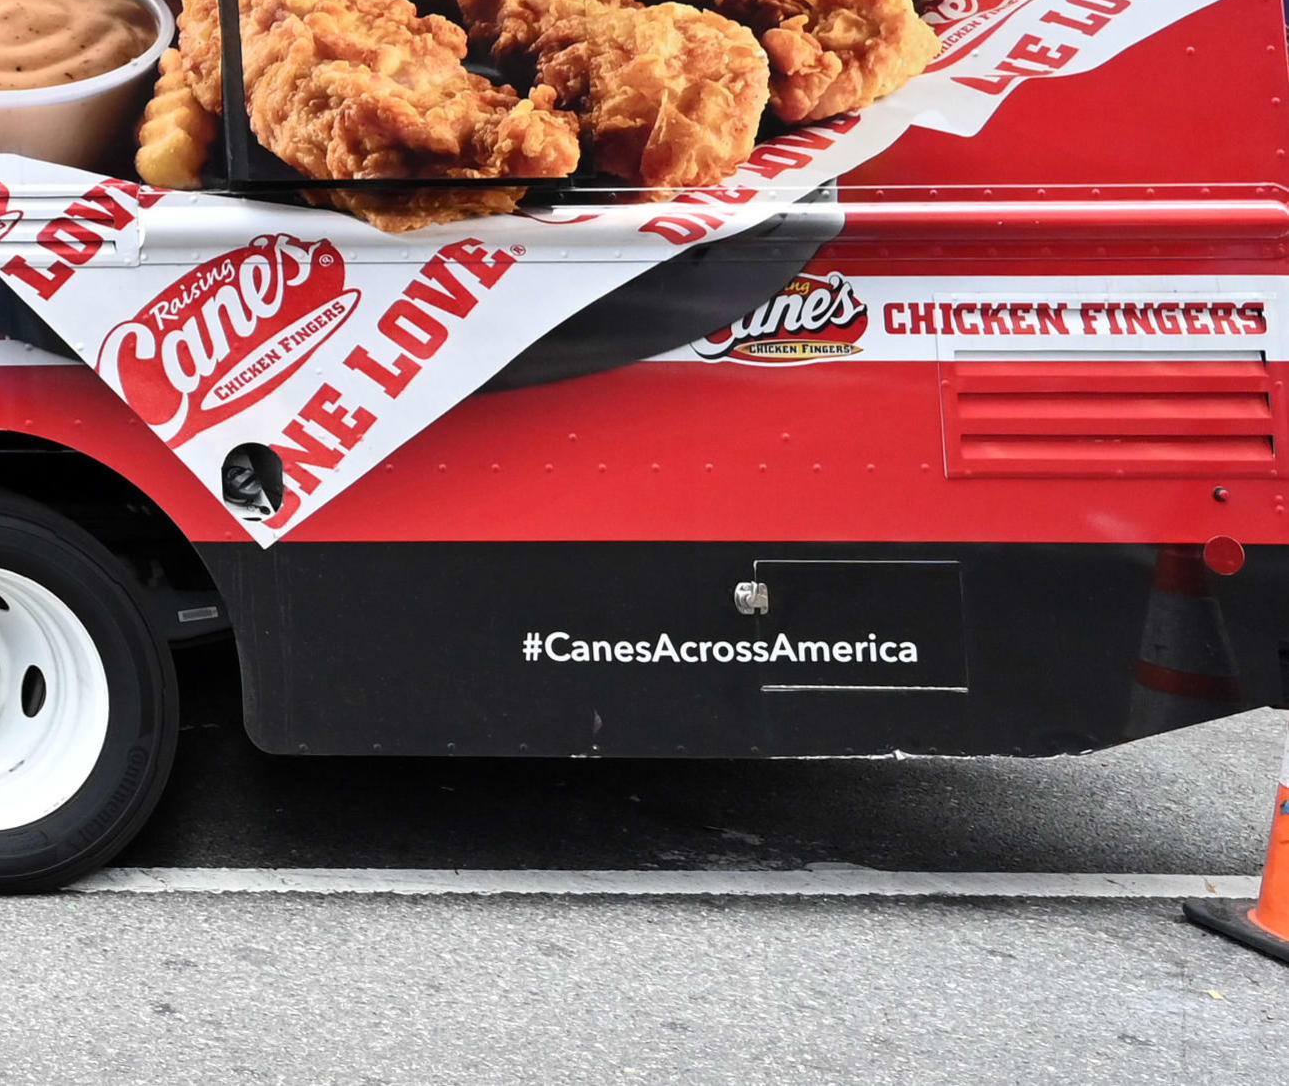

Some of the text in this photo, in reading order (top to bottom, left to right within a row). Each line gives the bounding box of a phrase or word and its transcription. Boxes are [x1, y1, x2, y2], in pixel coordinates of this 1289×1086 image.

[149, 259, 235, 331] Raising
[884, 302, 1268, 335] CHICKEN FINGERS
[98, 234, 330, 448] Cane's
[213, 299, 347, 402] CHICKEN FINGERS
[749, 344, 850, 354] CHICKEN FINGERS
[523, 632, 919, 664] #CanesAcrossAmerica
